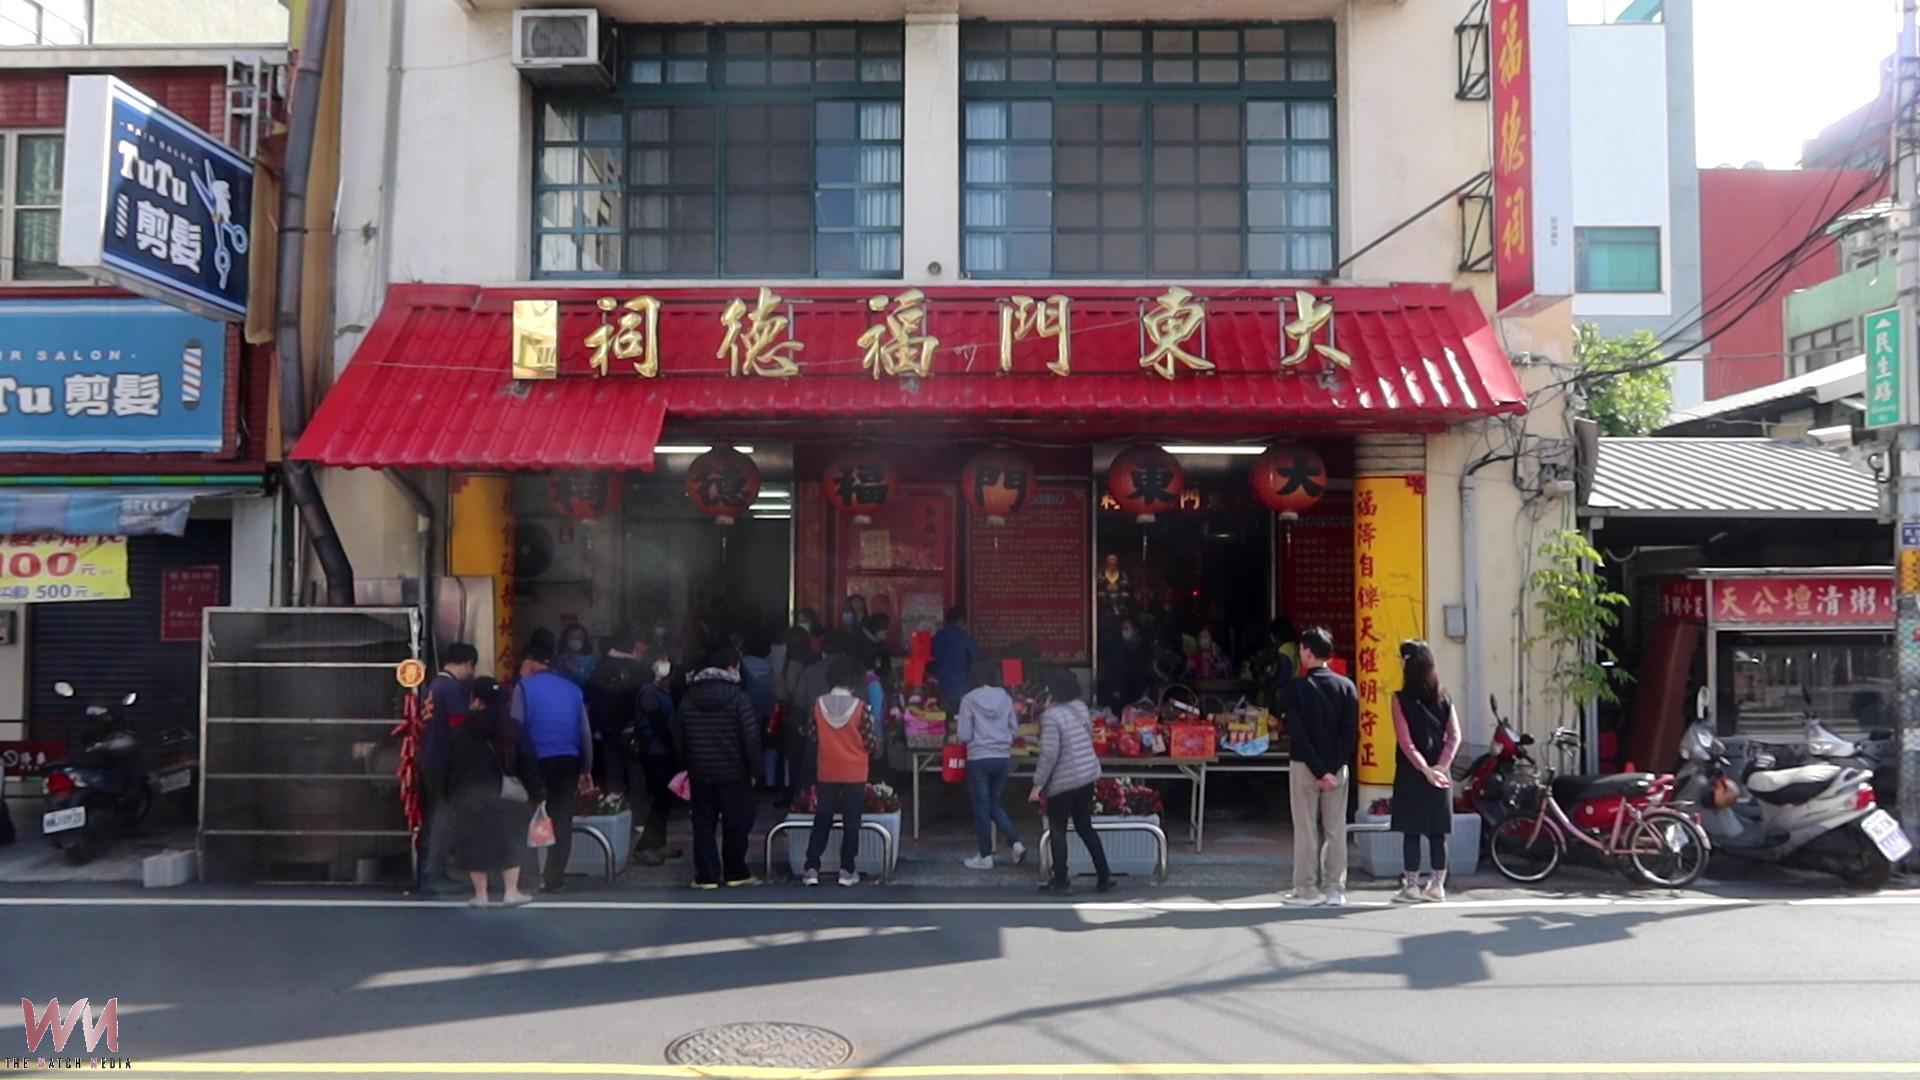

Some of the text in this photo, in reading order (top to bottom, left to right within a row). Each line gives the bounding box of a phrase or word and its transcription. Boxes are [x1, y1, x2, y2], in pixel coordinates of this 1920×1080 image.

[118, 139, 188, 206] TuTu
[136, 199, 202, 274] 剪髮
[36, 350, 122, 361] SALON
[1874, 331, 1894, 401] 民生路
[64, 372, 161, 418] 剪髮
